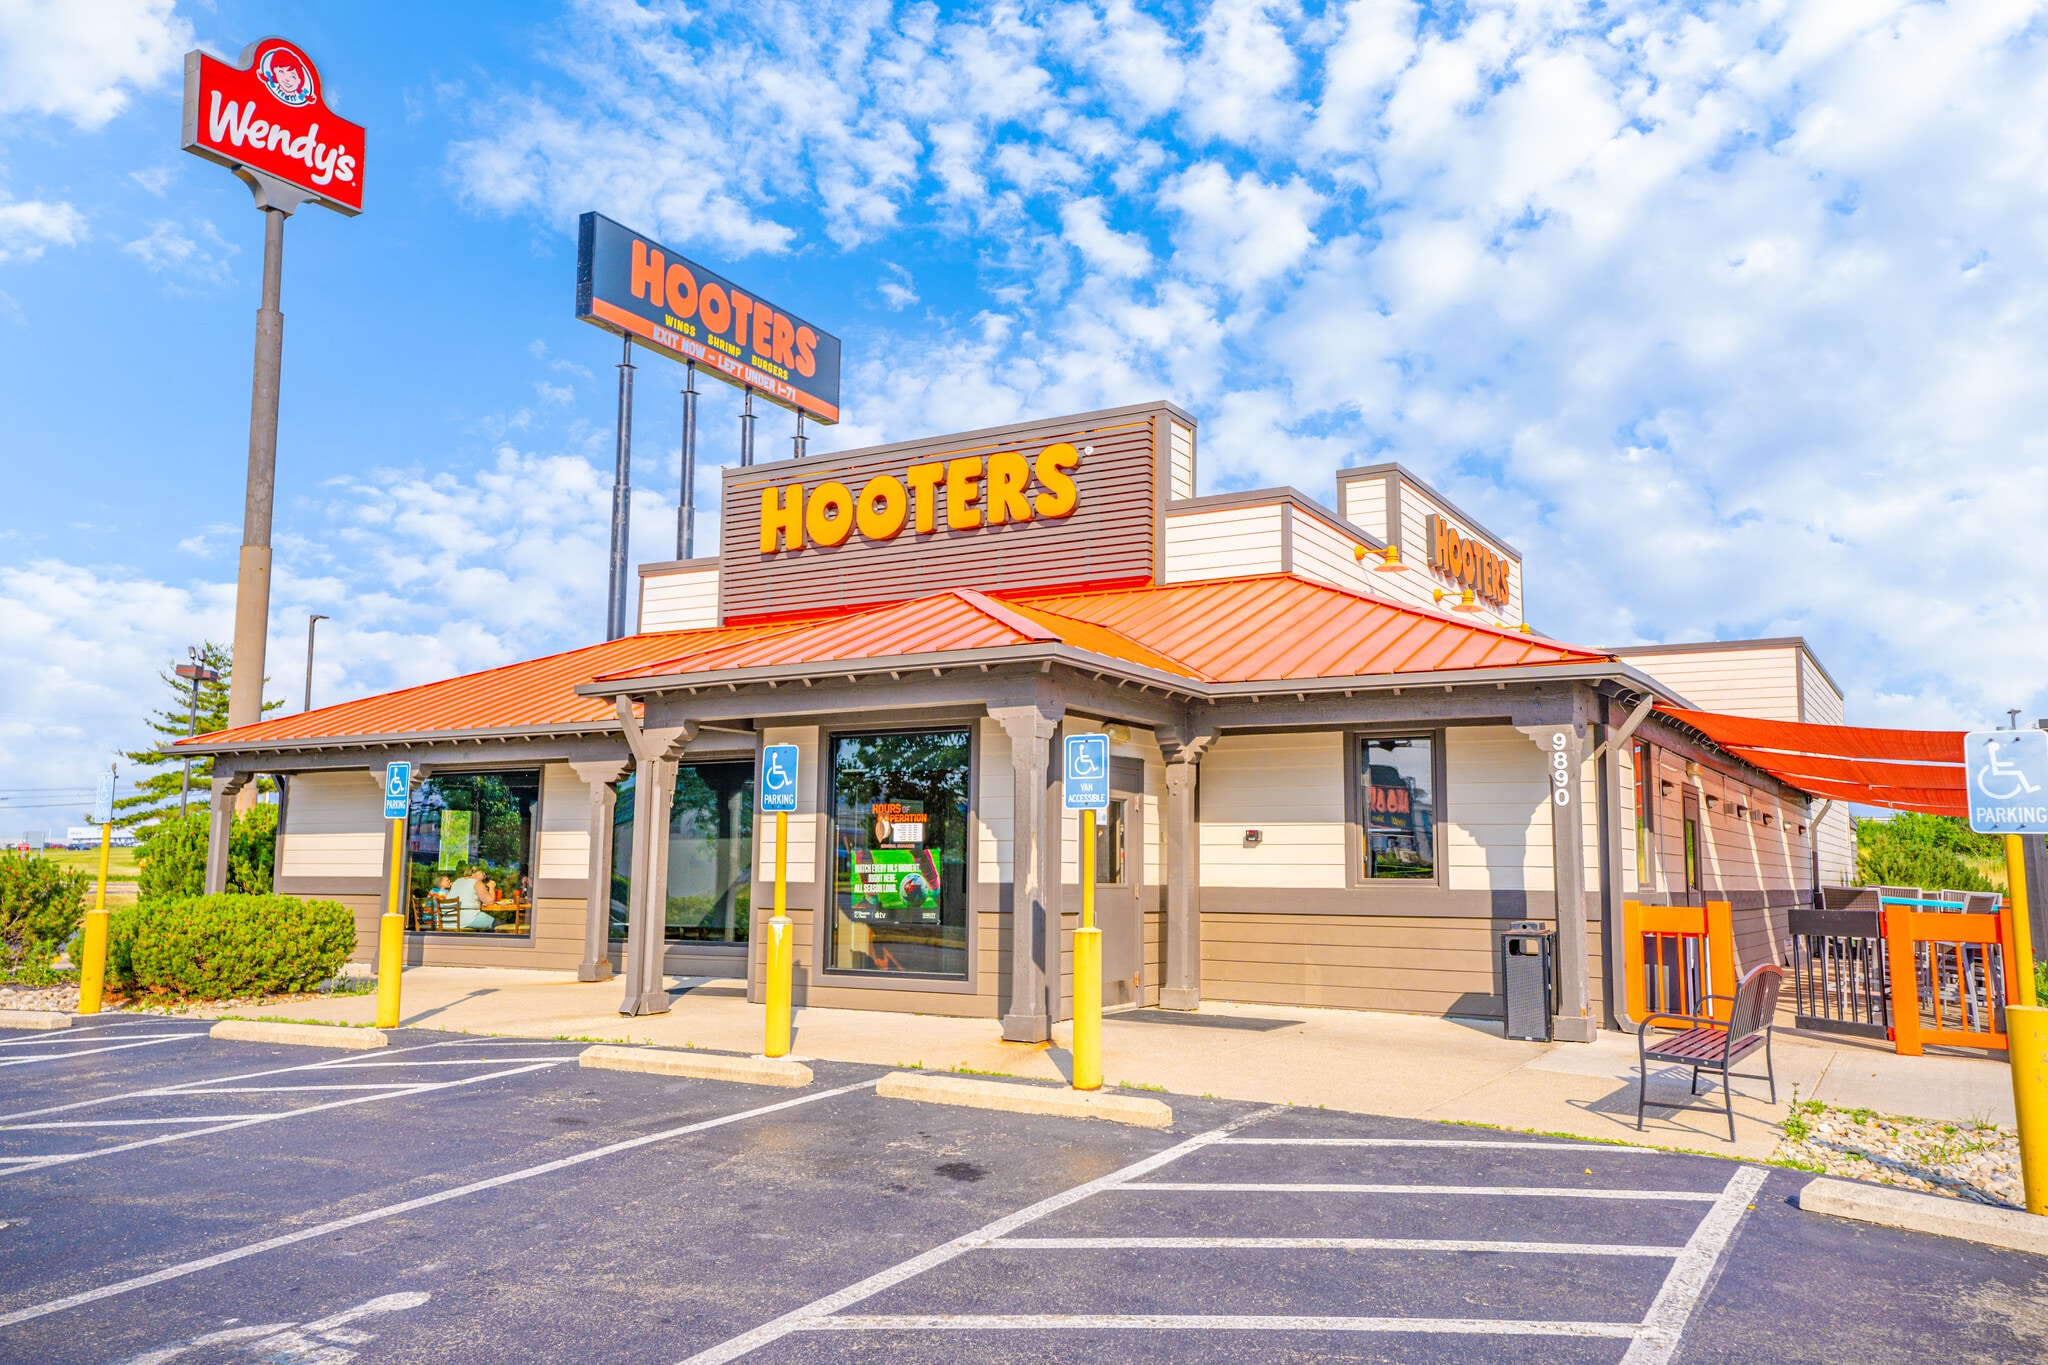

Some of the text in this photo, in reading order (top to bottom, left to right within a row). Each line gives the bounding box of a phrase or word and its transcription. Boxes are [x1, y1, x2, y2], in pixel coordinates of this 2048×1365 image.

[209, 90, 356, 186] Wendy's
[630, 239, 817, 377] HOOTERS
[653, 325, 679, 349] EXIT
[681, 338, 706, 360] NOW
[717, 354, 743, 377] LEFT
[745, 367, 776, 393] UNDER
[777, 382, 797, 401] I-71
[665, 314, 789, 381] WINGS SHRIMP BURGERS
[759, 442, 1081, 554] HOOTERS
[1428, 513, 1510, 606] HOOTERS
[764, 793, 794, 805] PARKING
[1068, 793, 1105, 802] ACCESSIBLE
[1080, 783, 1093, 792] VAN
[1552, 732, 1570, 806] 9890
[387, 799, 406, 809] PARKING
[872, 803, 911, 814] HOURS OF
[1976, 807, 2047, 823] PARKING
